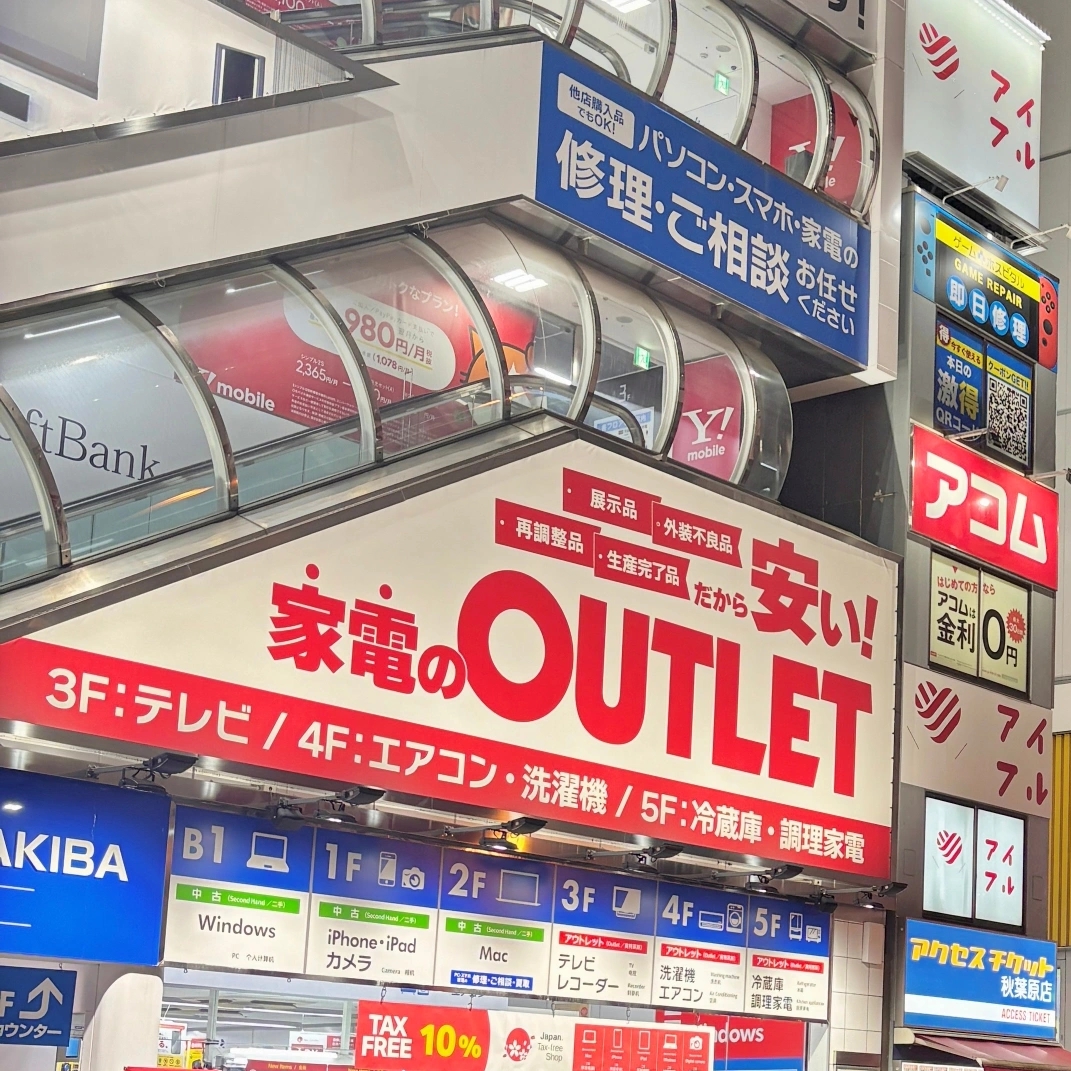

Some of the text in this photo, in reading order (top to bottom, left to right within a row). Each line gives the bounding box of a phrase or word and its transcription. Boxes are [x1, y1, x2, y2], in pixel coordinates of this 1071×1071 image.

[569, 83, 624, 125] 他店購入品
[577, 105, 616, 135] でもOK!
[639, 125, 858, 269] パソコン・スマホ・家電の
[556, 130, 789, 303] 修理・ご相談
[795, 259, 857, 312] お任せ
[954, 258, 1023, 309] GAME REPAIR
[798, 295, 855, 335] ください
[950, 278, 1028, 345] 即日修理
[938, 324, 950, 344] 得
[947, 355, 972, 379] 本日の
[217, 379, 276, 413] mobile
[937, 368, 979, 420] 激得
[682, 406, 734, 445] Y!
[0, 407, 161, 482] ftBank
[687, 445, 726, 462] mobile
[590, 488, 638, 520] 展示品
[926, 451, 1048, 564] アコム
[515, 518, 584, 553] 再調整品
[663, 518, 733, 555] 外装不良品
[607, 550, 680, 587] 生産完了品
[694, 581, 748, 619] だから
[750, 538, 879, 660] 安い!
[937, 576, 996, 595] はじめての方なら
[937, 591, 976, 619] アコムは
[457, 569, 873, 798] OUTLET
[182, 825, 225, 864] B1
[326, 843, 362, 882] 1F
[448, 862, 487, 898] 2F
[561, 880, 595, 912] 3F
[662, 895, 694, 926] 4F
[198, 914, 276, 938] Windows
[754, 907, 781, 938] 5F
[479, 946, 508, 963] Mac
[564, 933, 604, 947] アウトレット
[665, 946, 702, 959] アウトレット
[326, 952, 372, 972] カメラ
[558, 953, 595, 972] テレビ
[757, 957, 789, 969] アウトレット
[910, 938, 1054, 979] アクセスチケット
[557, 974, 619, 994] レコーダー
[660, 965, 696, 984] 洗濯機
[752, 974, 784, 992] 冷蔵庫
[1000, 975, 1052, 1002] 秋葉原店
[659, 985, 703, 1003] エアコン
[751, 993, 793, 1012] 調理家電
[1001, 1008, 1050, 1024] ACCESS TICKET
[361, 1036, 413, 1059] FREE
[368, 1014, 482, 1058] TAX 10%
[538, 1043, 563, 1052] Tax-free
[546, 1053, 563, 1062] Shop
